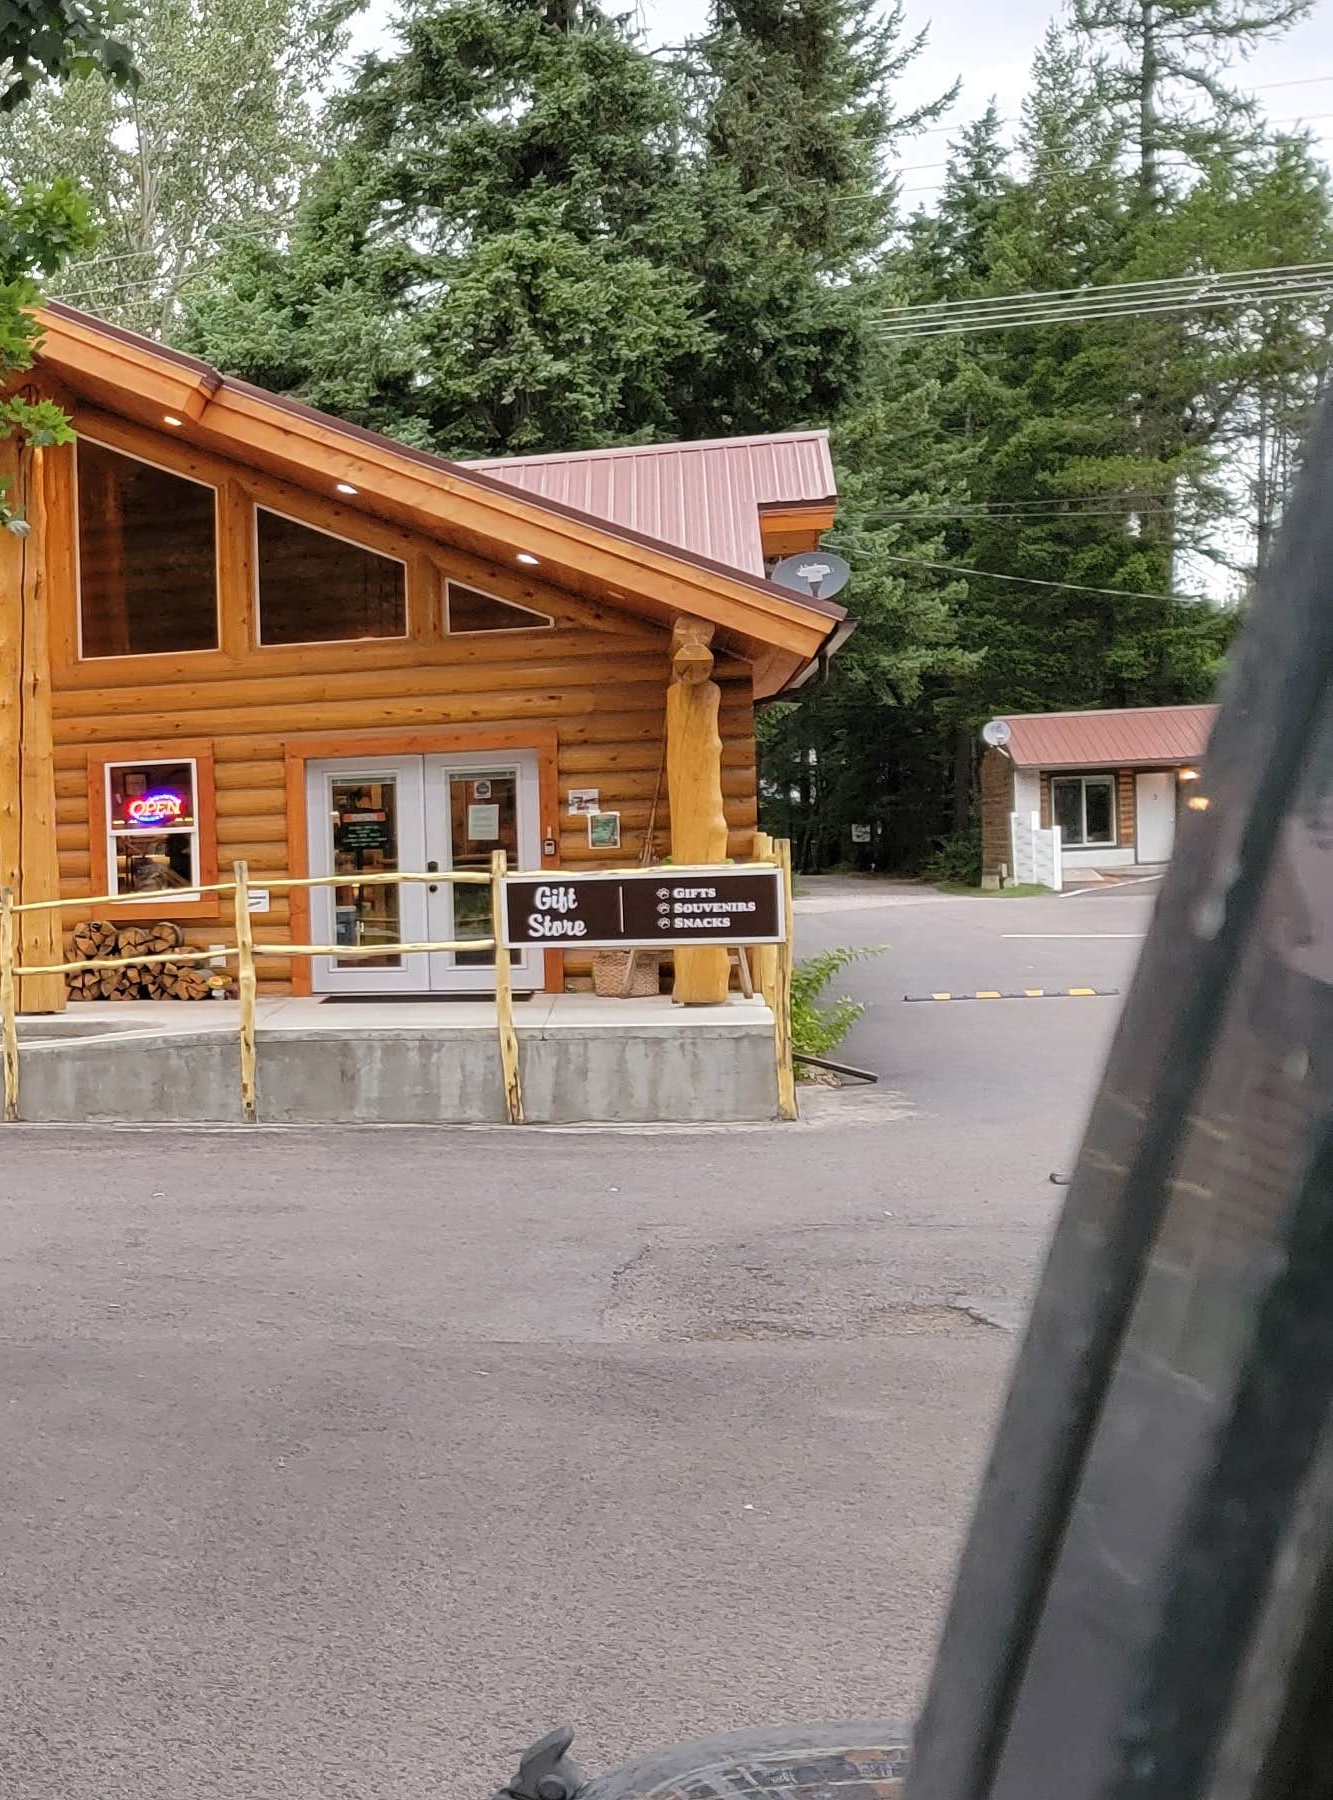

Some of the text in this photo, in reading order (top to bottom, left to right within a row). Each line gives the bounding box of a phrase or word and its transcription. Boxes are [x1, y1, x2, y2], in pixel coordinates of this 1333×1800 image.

[129, 800, 182, 817] OPEN
[535, 886, 578, 913] Gift
[673, 888, 717, 898] GIFTS
[674, 902, 756, 913] SOUVENIRS
[528, 913, 587, 937] Store
[674, 917, 731, 928] SNACKS
